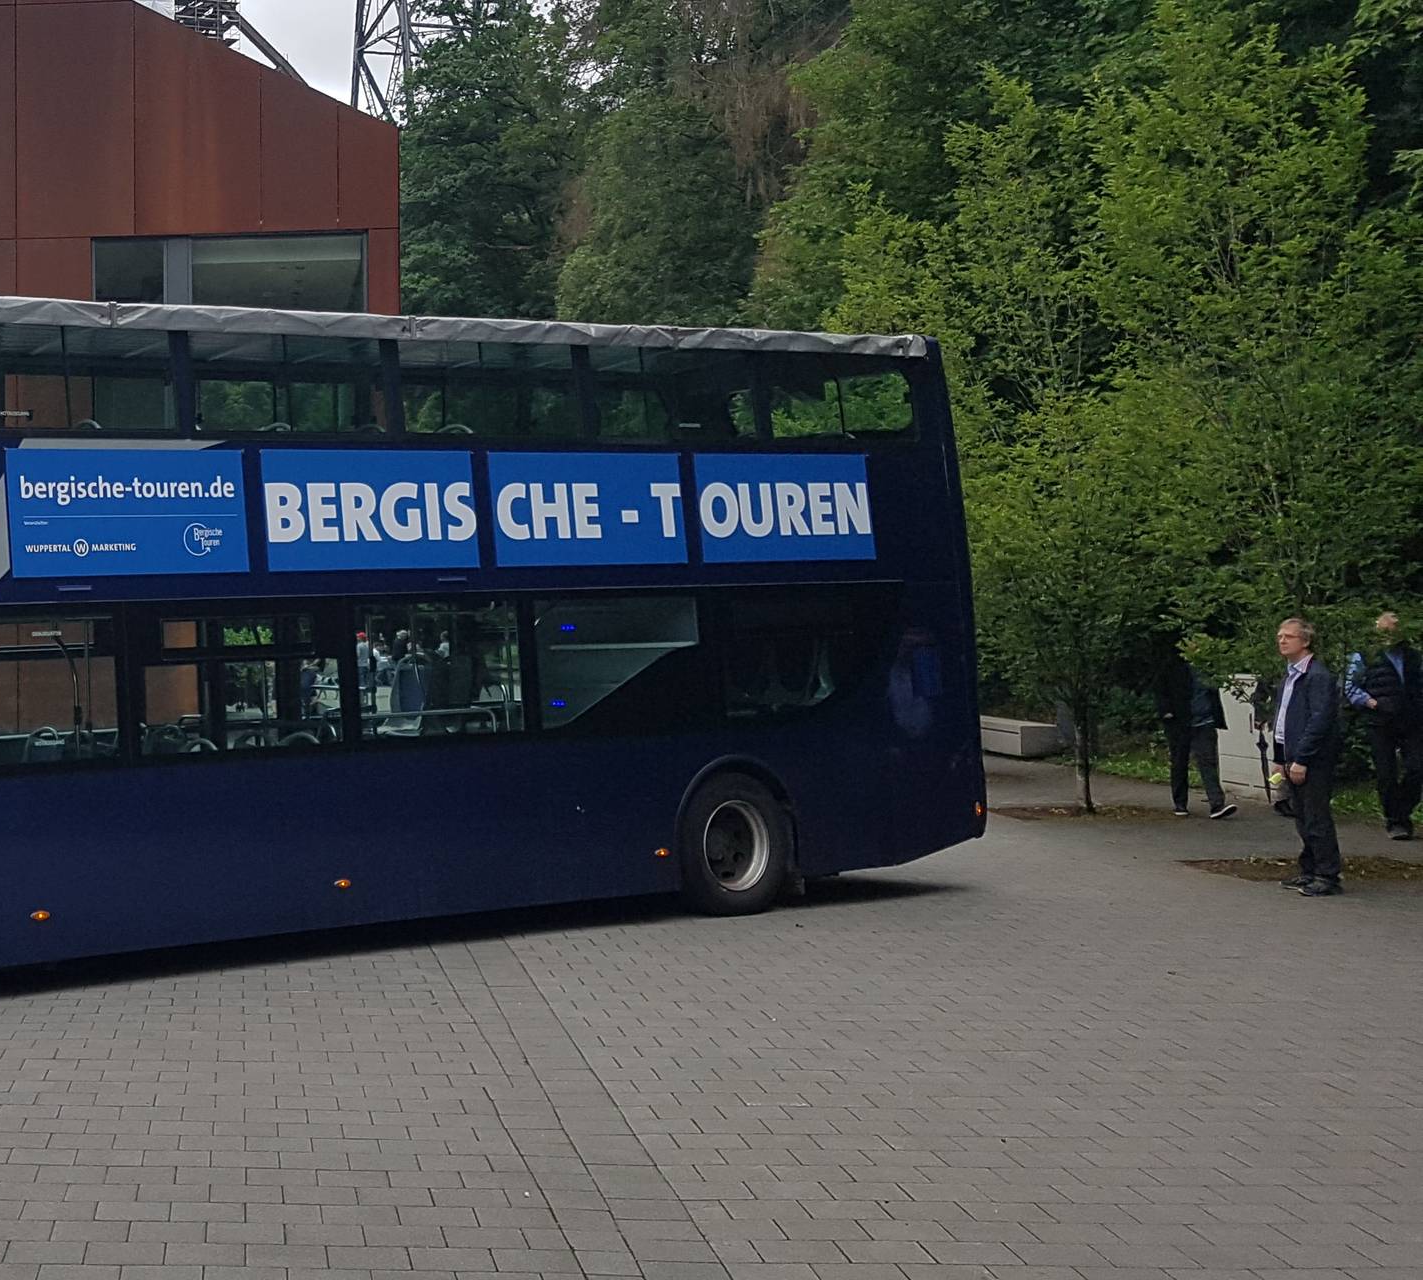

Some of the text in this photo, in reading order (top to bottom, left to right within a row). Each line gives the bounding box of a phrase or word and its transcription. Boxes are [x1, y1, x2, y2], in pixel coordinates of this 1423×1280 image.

[20, 475, 235, 506] bergische-touren.de
[193, 527, 223, 541] Bergische
[25, 544, 71, 553] WUPPERTAL
[91, 543, 136, 552] MARKETING
[200, 537, 220, 550] Touren
